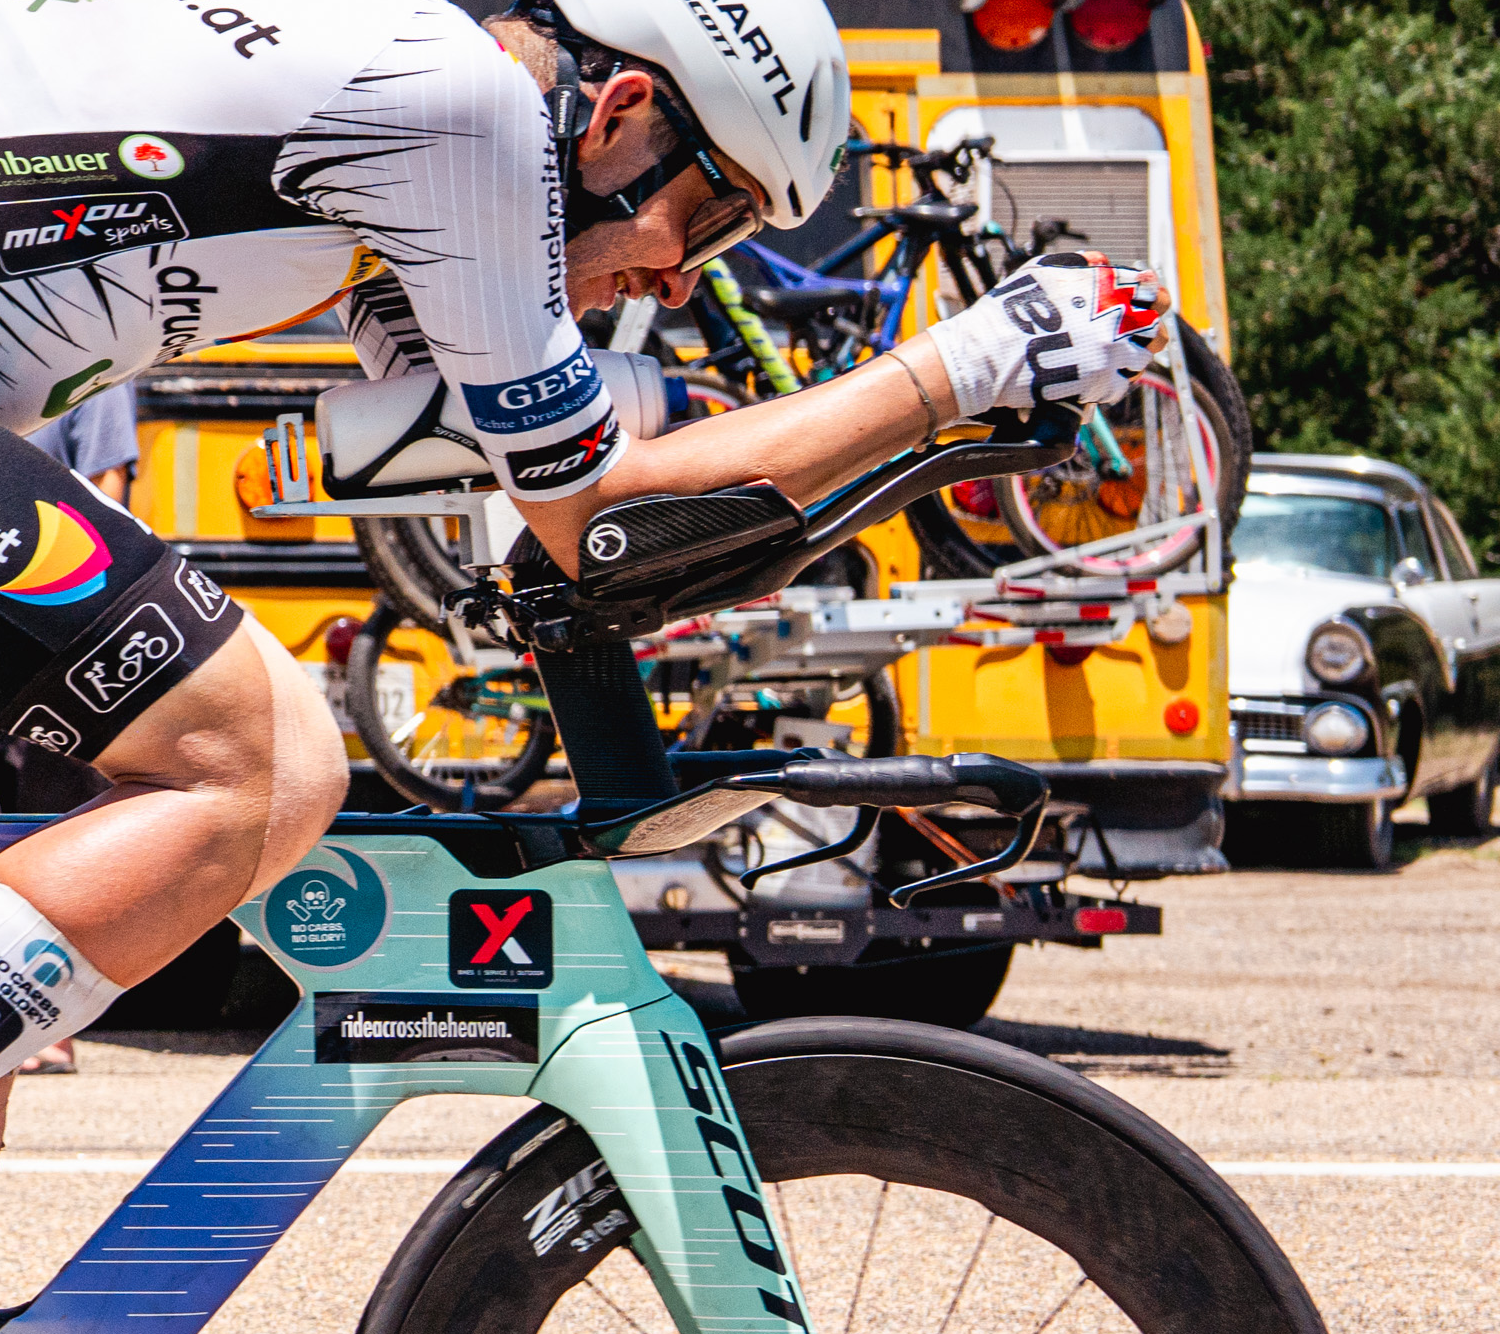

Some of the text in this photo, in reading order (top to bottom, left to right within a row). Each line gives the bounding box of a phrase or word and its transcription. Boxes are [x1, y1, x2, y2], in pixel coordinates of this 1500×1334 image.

[104, 214, 175, 245] sports
[291, 924, 307, 933] NO
[291, 932, 346, 943] NO GLORY!
[341, 1011, 512, 1038] rideacrosstheheaven.
